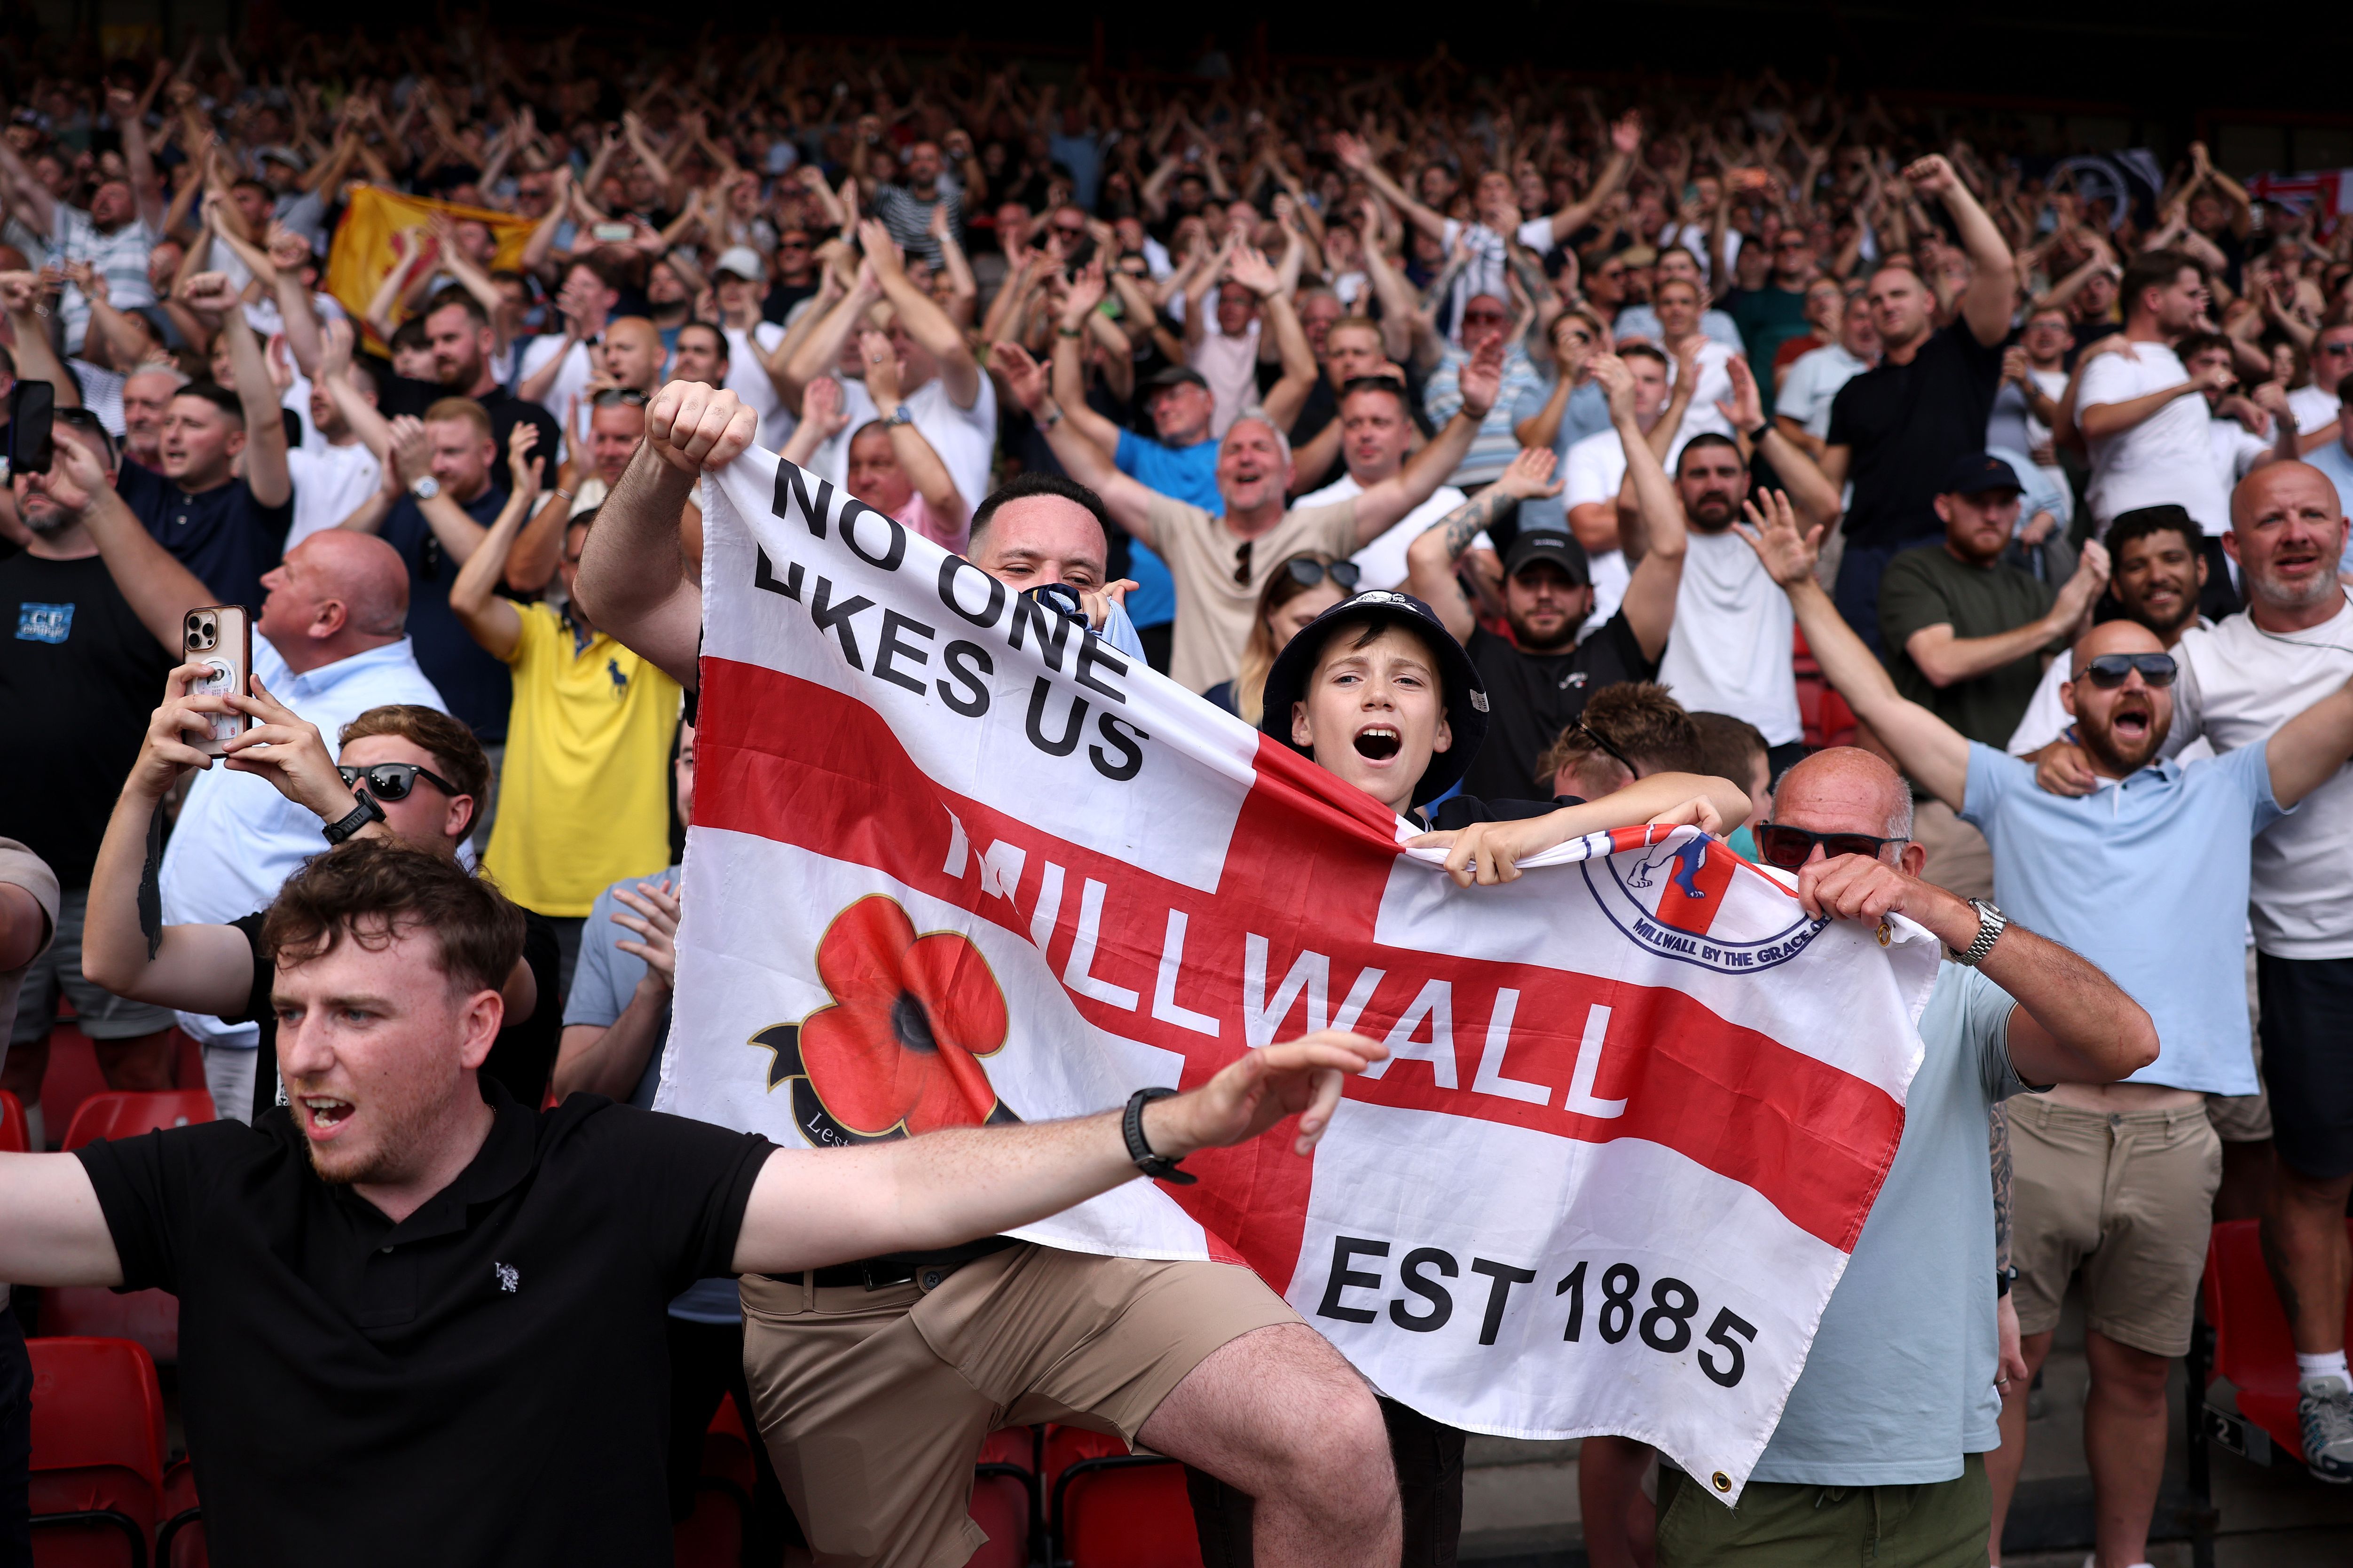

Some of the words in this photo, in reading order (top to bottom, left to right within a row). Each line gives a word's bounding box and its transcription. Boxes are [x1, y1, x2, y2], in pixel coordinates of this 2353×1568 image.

[771, 458, 906, 571] NO
[938, 555, 1129, 704] ONE
[1025, 677, 1150, 781] US
[940, 800, 1629, 1119] MILLWALL
[1633, 917, 1696, 956] MILLWALL
[1702, 945, 1721, 963] BY
[1724, 951, 1753, 967] THE
[1757, 929, 1811, 964] GRACE
[1316, 1235, 1537, 1346] EST
[1555, 1261, 1758, 1388] 1885
[2216, 1418, 2231, 1444] 2
